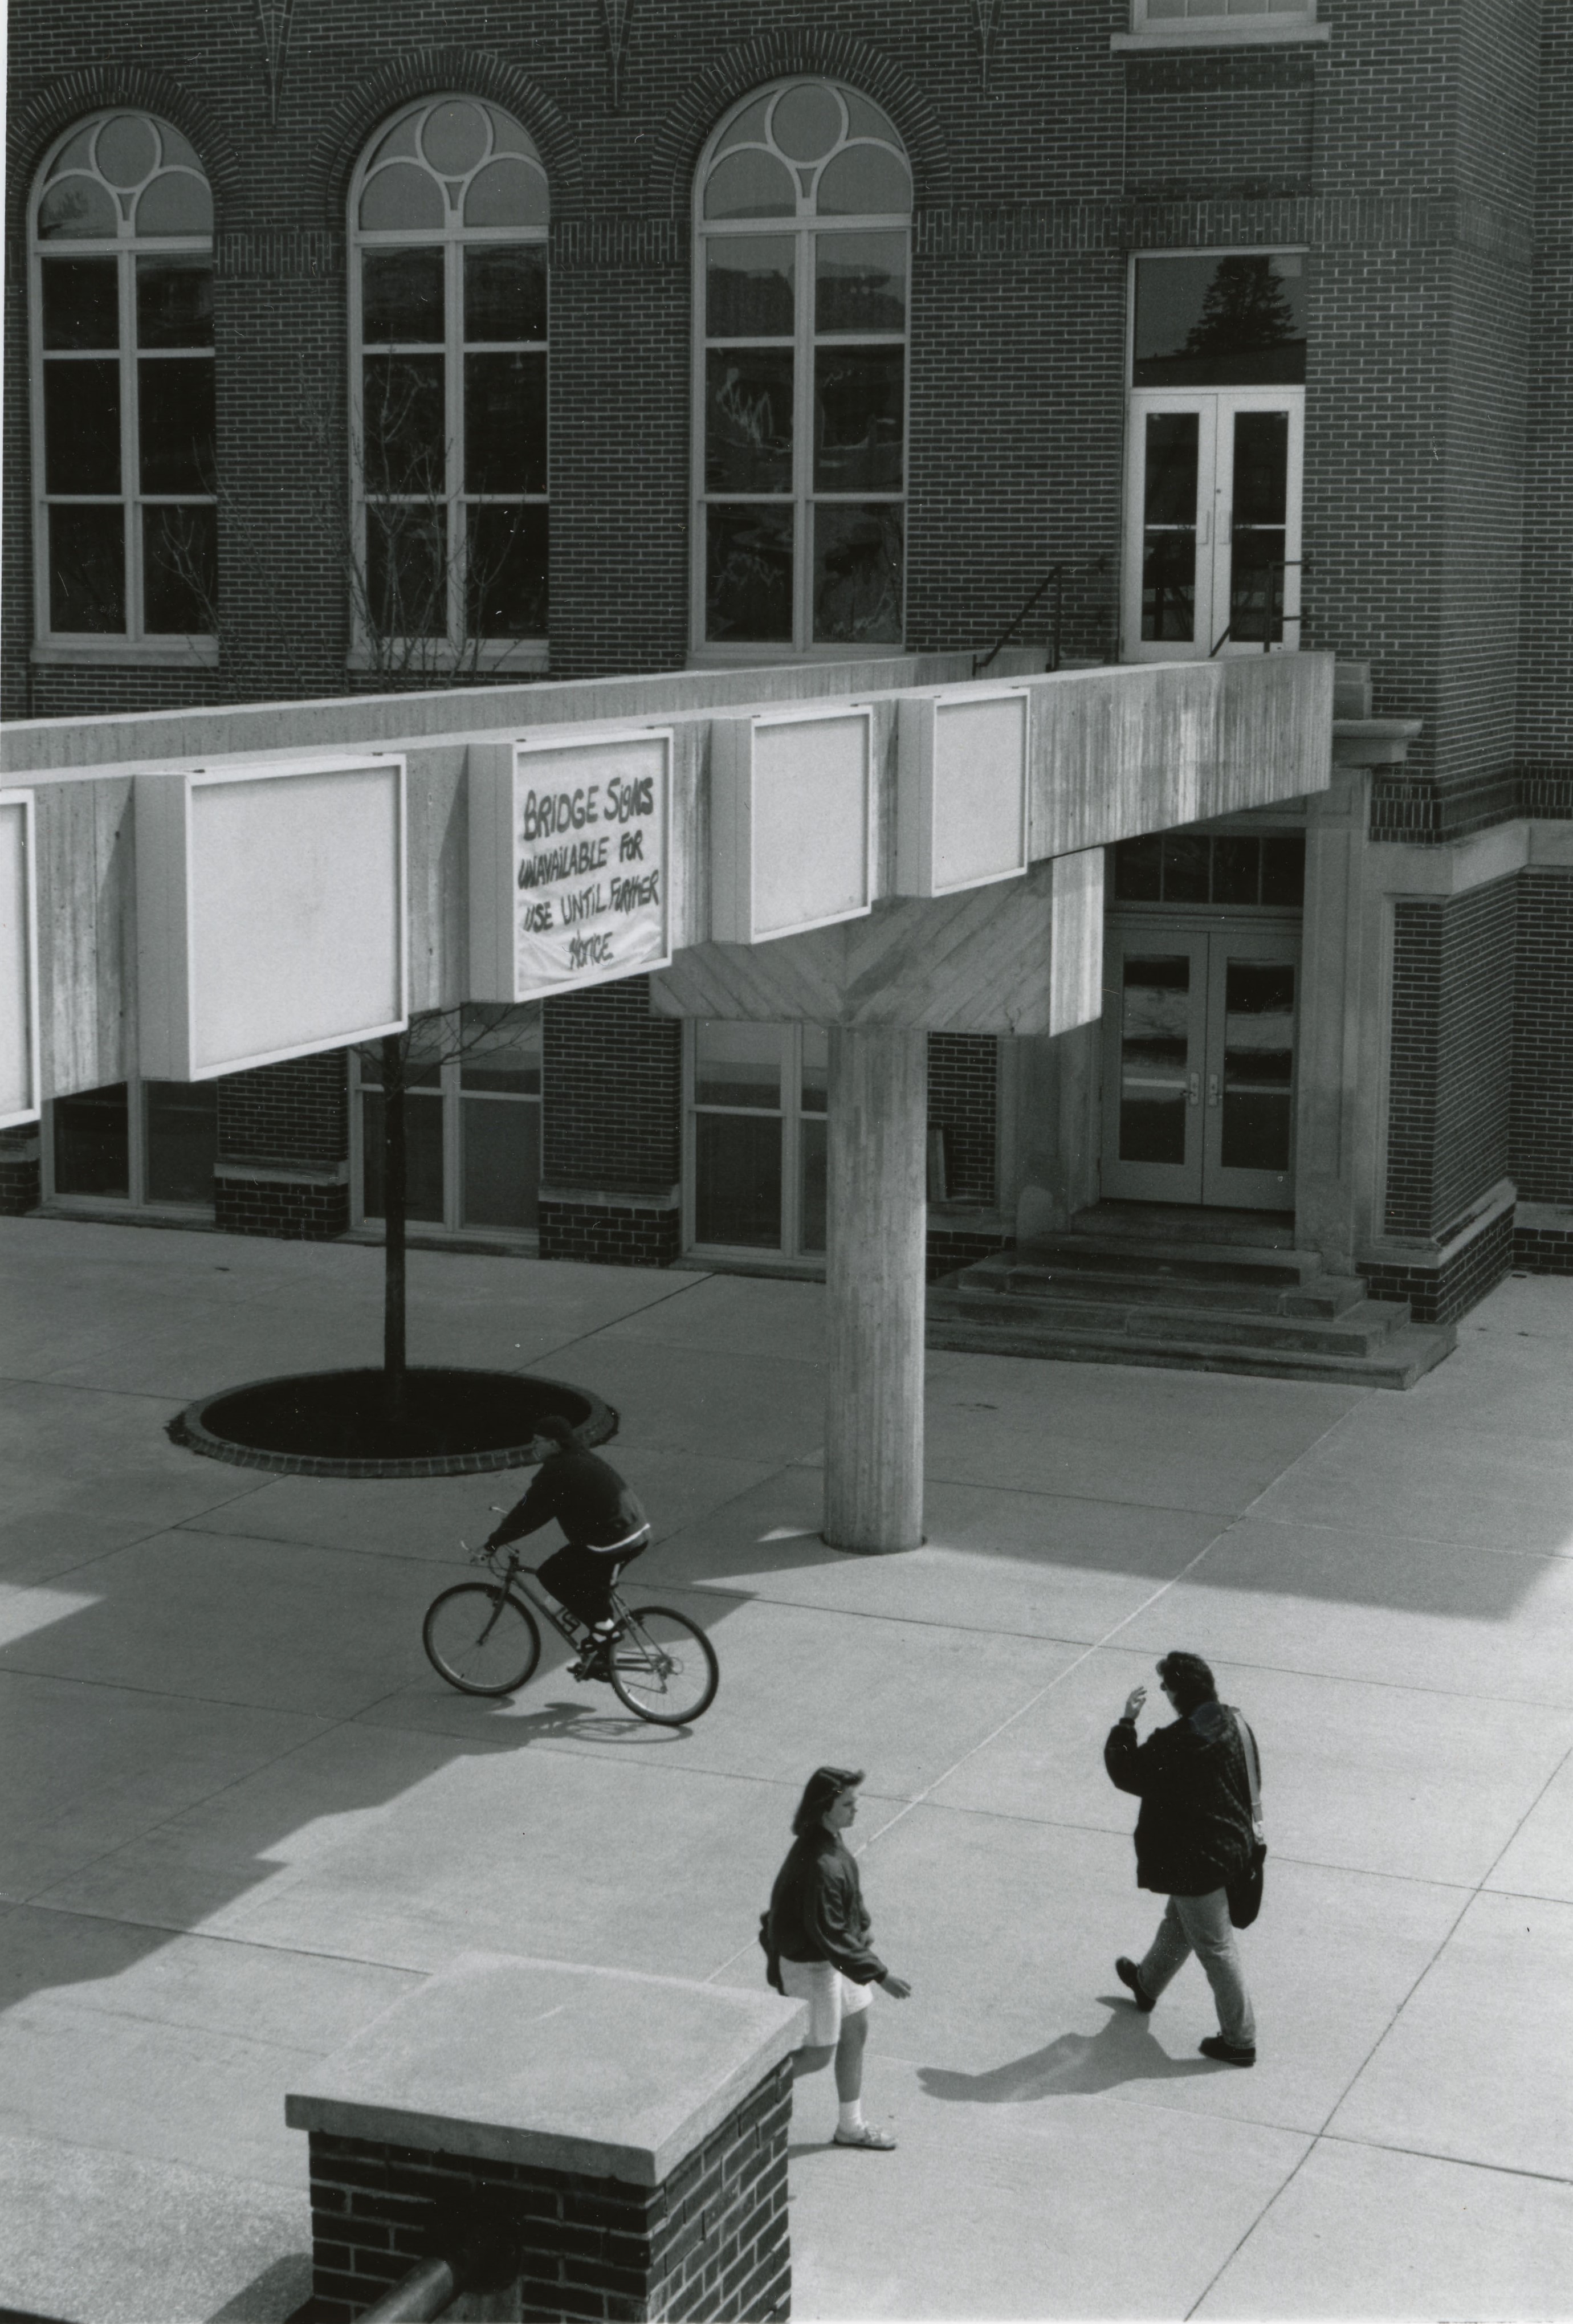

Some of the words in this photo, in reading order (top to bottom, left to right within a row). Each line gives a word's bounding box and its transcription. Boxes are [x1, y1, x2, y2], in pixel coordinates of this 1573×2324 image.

[523, 785, 599, 841] BRIDGE
[517, 837, 610, 890] UNAVAILABLE
[620, 830, 644, 862] FOR
[524, 902, 553, 933] USE
[561, 884, 608, 925] UNTIL
[570, 928, 614, 969] NOTICE
